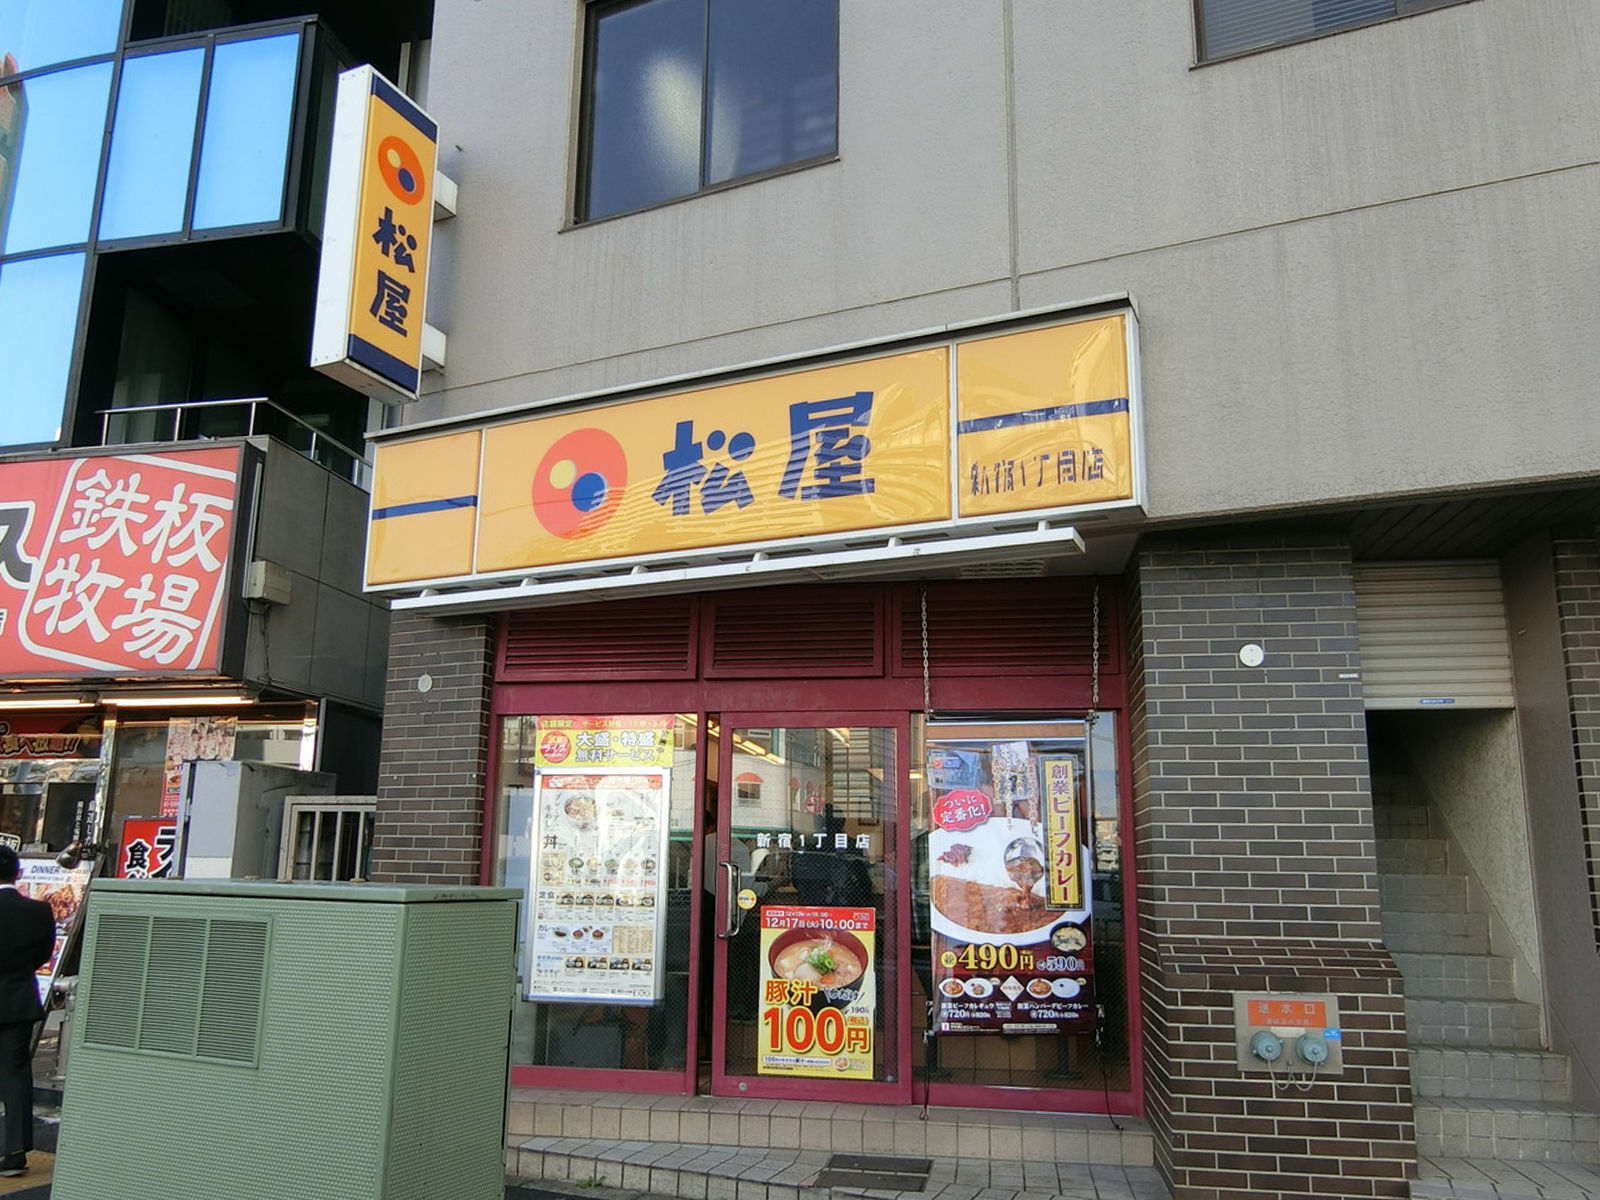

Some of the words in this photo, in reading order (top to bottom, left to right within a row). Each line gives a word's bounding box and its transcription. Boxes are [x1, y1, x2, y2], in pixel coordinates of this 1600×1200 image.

[371, 206, 417, 338] 松屋
[652, 391, 876, 516] 松屋
[60, 469, 234, 572] 鉄板
[33, 553, 202, 665] 牧場
[576, 731, 656, 748] 大盛・特盛
[575, 749, 656, 762] 無料サービス
[943, 794, 978, 809] ついに
[940, 803, 987, 824] 定番化!
[543, 834, 558, 849] 丼
[756, 833, 870, 849] 新宿1丁目店
[1051, 764, 1075, 901] 創業ビーフカレー
[31, 865, 60, 874] DINNER
[765, 980, 817, 1004] 豚汁
